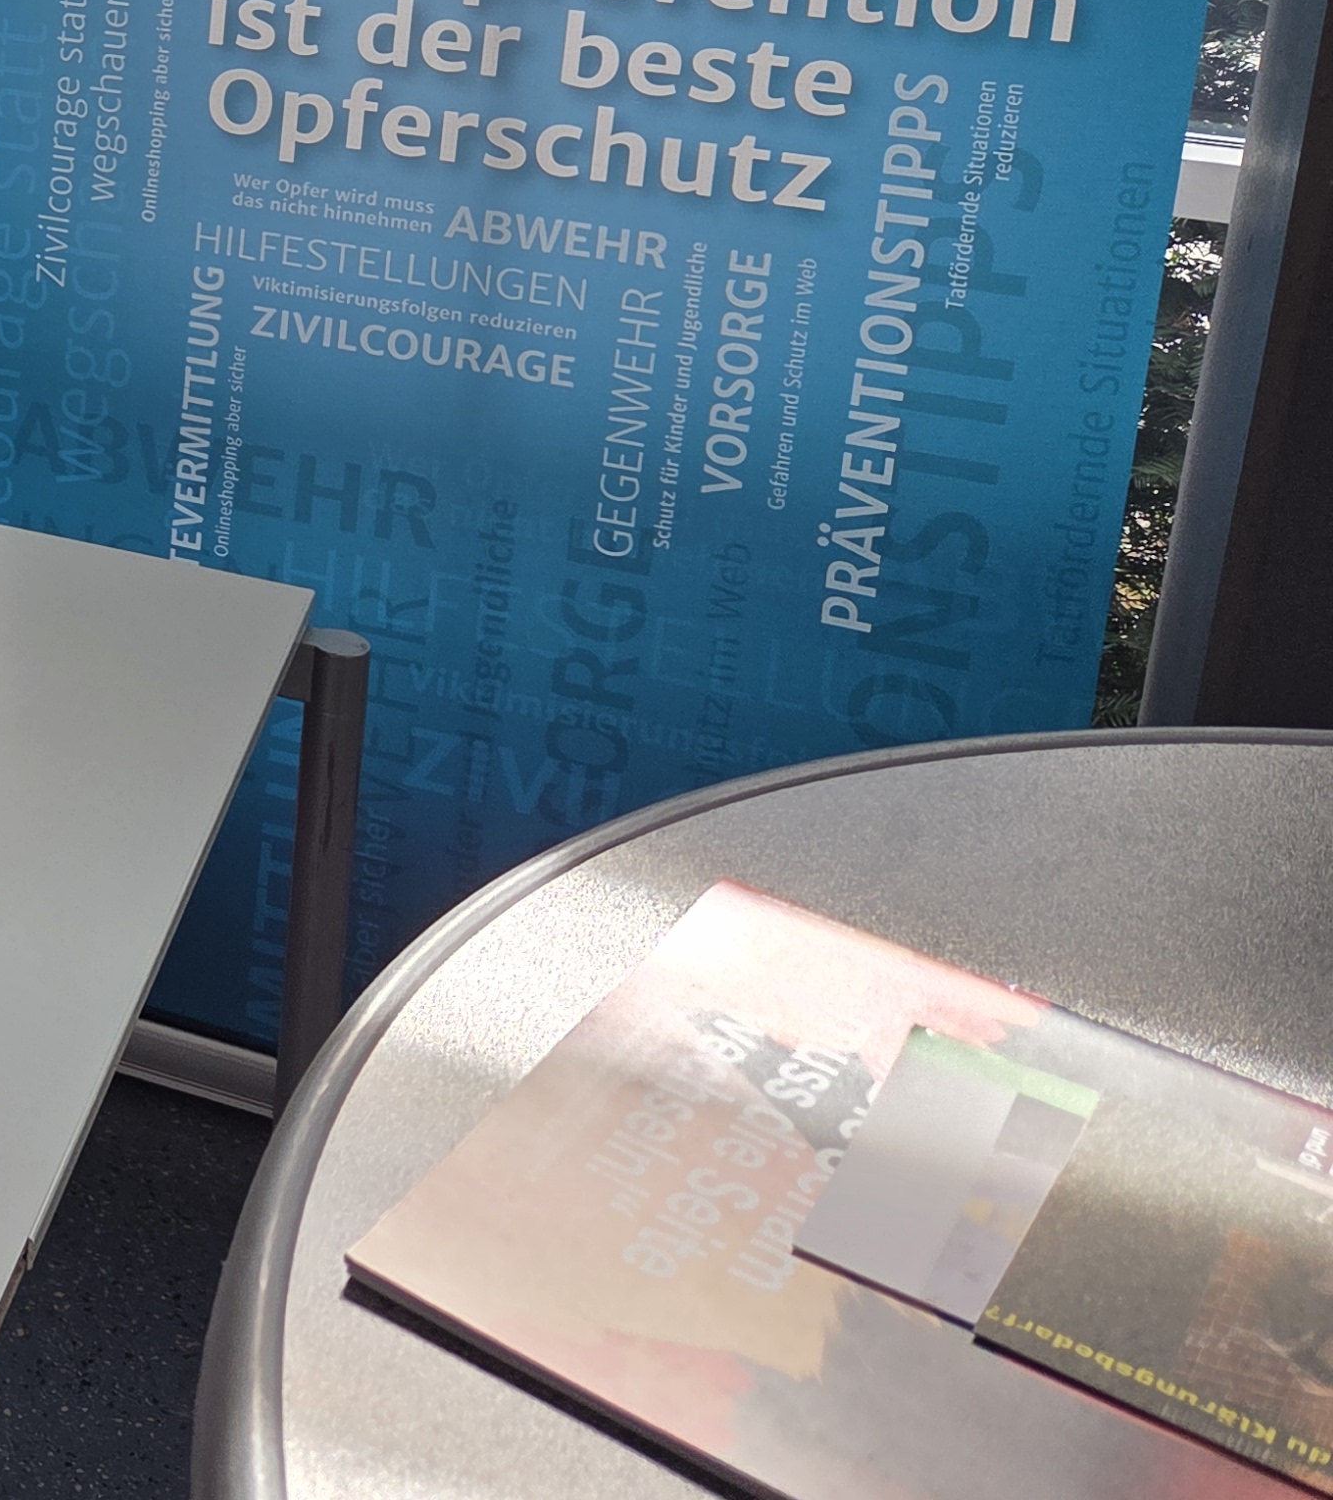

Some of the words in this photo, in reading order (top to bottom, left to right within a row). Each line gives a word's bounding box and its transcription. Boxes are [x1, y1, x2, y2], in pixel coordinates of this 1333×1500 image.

[559, 9, 854, 117] beste
[35, 77, 88, 288] Zivilcourage
[208, 67, 833, 212] Opferschutz
[233, 172, 269, 192] Wer
[275, 179, 331, 203] Opfer
[334, 187, 378, 207] wird
[384, 196, 435, 215] muss
[944, 190, 982, 310] Tatfördernde
[969, 79, 997, 188] Situationen
[994, 83, 1025, 182] reduzieren
[194, 222, 587, 311] HILFESTELLUNGEN
[232, 193, 266, 211] das
[269, 196, 318, 218] nicht
[323, 205, 432, 234] hinnehmen
[443, 204, 668, 270] ABWEHR
[249, 305, 576, 389] ZIVILCOURAGE
[700, 250, 772, 493] VORSORGE
[821, 72, 949, 633] PRÄVENTIONSTIPPS
[168, 266, 225, 567] TEVERMITTLUNG
[593, 288, 663, 559] GEGENWEHR
